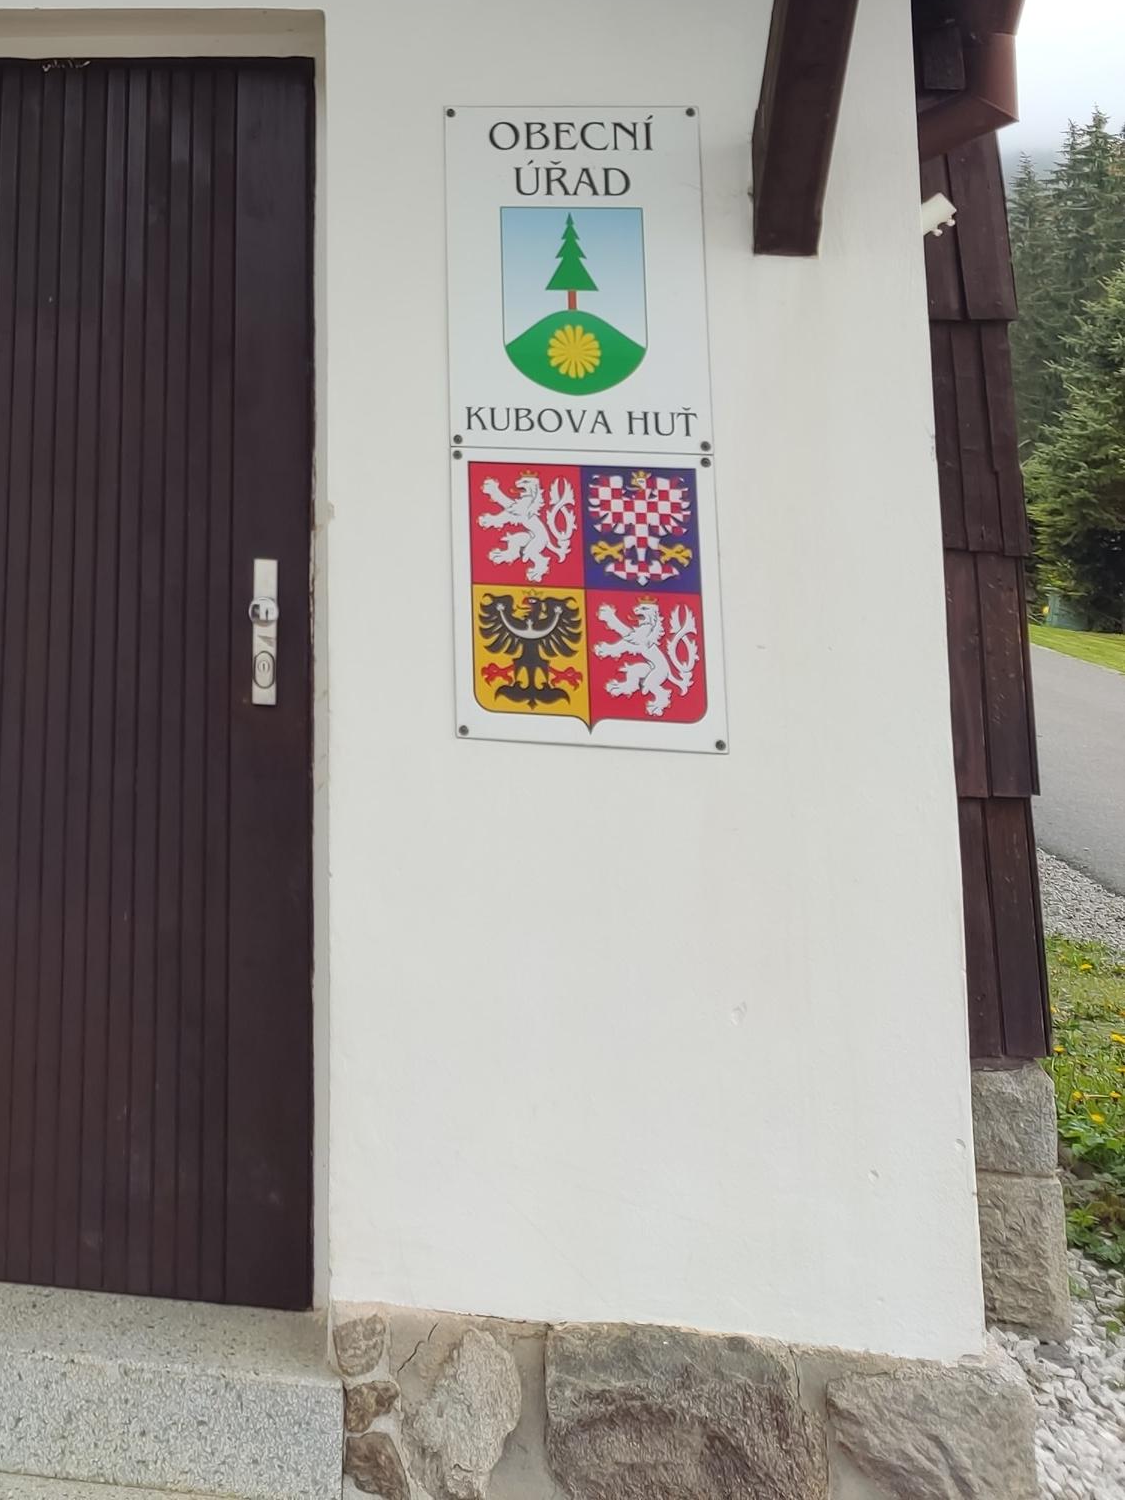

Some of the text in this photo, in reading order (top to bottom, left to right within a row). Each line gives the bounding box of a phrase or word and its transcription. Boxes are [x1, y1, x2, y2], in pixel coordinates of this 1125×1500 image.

[488, 115, 654, 151] OBECNÍ
[513, 159, 631, 196] ÚŘAD
[465, 406, 698, 437] KUBOVA HUŤ
